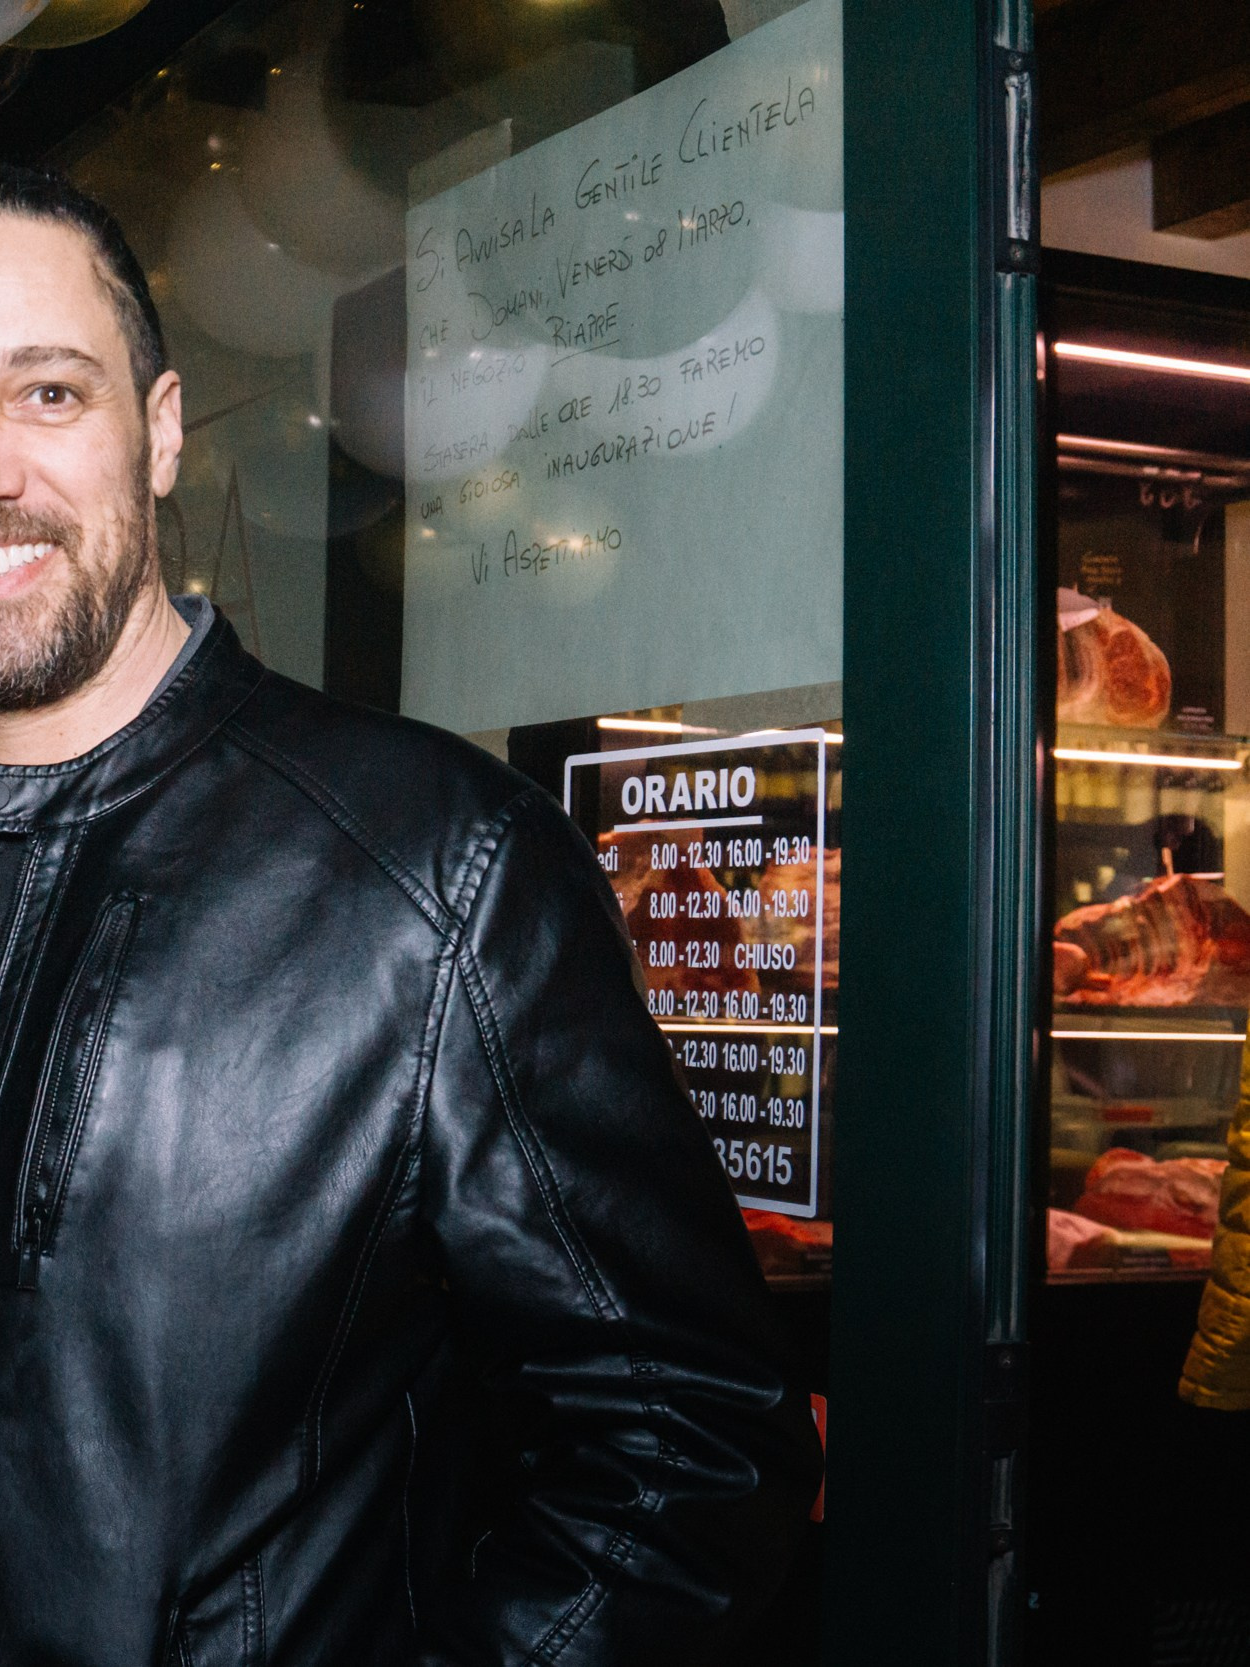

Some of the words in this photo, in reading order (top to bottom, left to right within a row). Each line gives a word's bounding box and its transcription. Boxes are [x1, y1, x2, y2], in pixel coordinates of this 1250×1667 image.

[419, 319, 449, 350] CHE
[421, 496, 443, 519] UNA
[621, 766, 756, 815] ORARIO
[734, 943, 795, 970] CHIUSO
